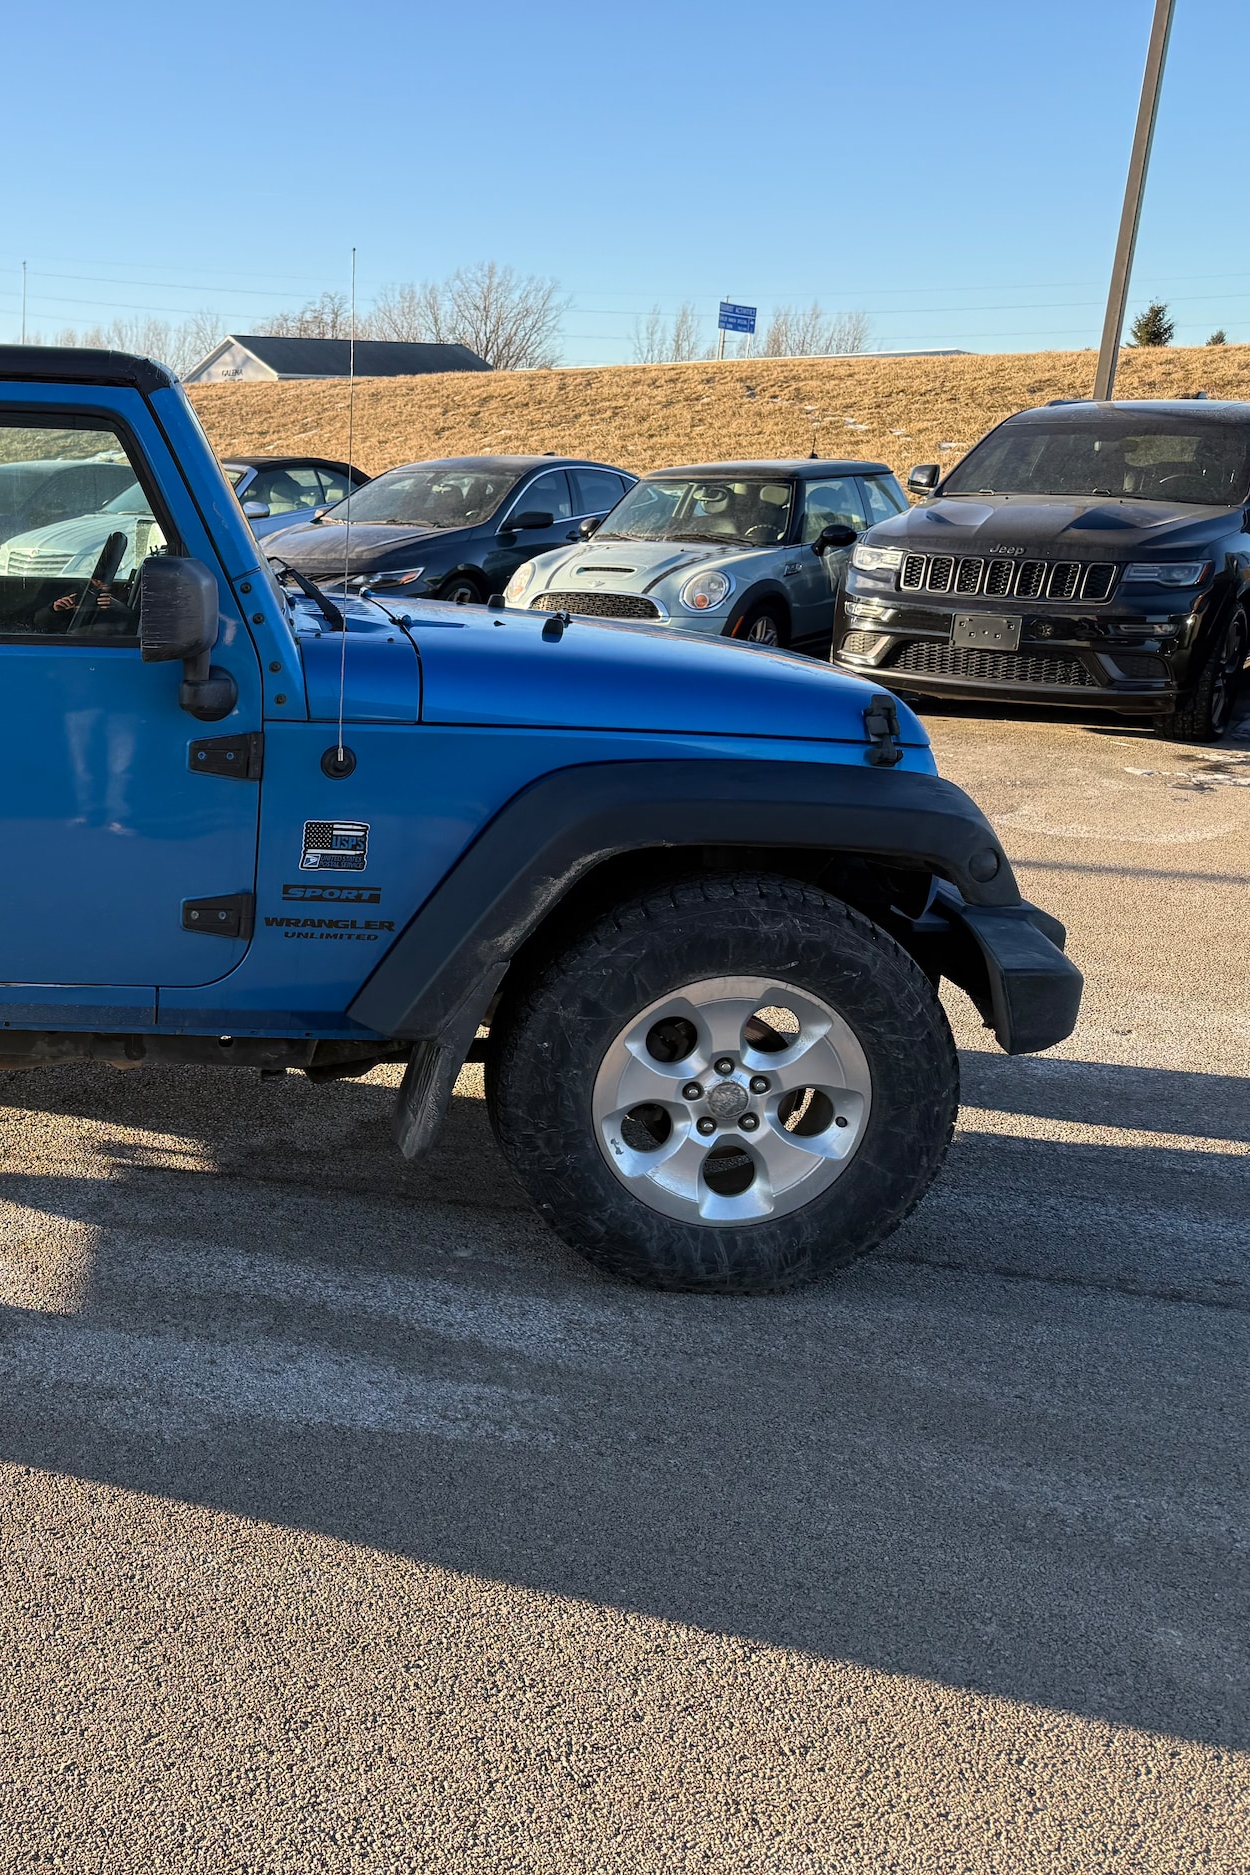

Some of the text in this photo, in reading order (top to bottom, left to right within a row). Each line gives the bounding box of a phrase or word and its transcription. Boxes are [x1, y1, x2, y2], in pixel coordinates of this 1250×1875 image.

[989, 543, 1025, 556] Jeep
[332, 835, 365, 850] USPS
[340, 861, 364, 869] SERVICE
[342, 855, 364, 863] STATES
[285, 887, 378, 901] SPORT
[264, 917, 395, 932] WRANGLER
[284, 931, 383, 942] UNLIMITED
